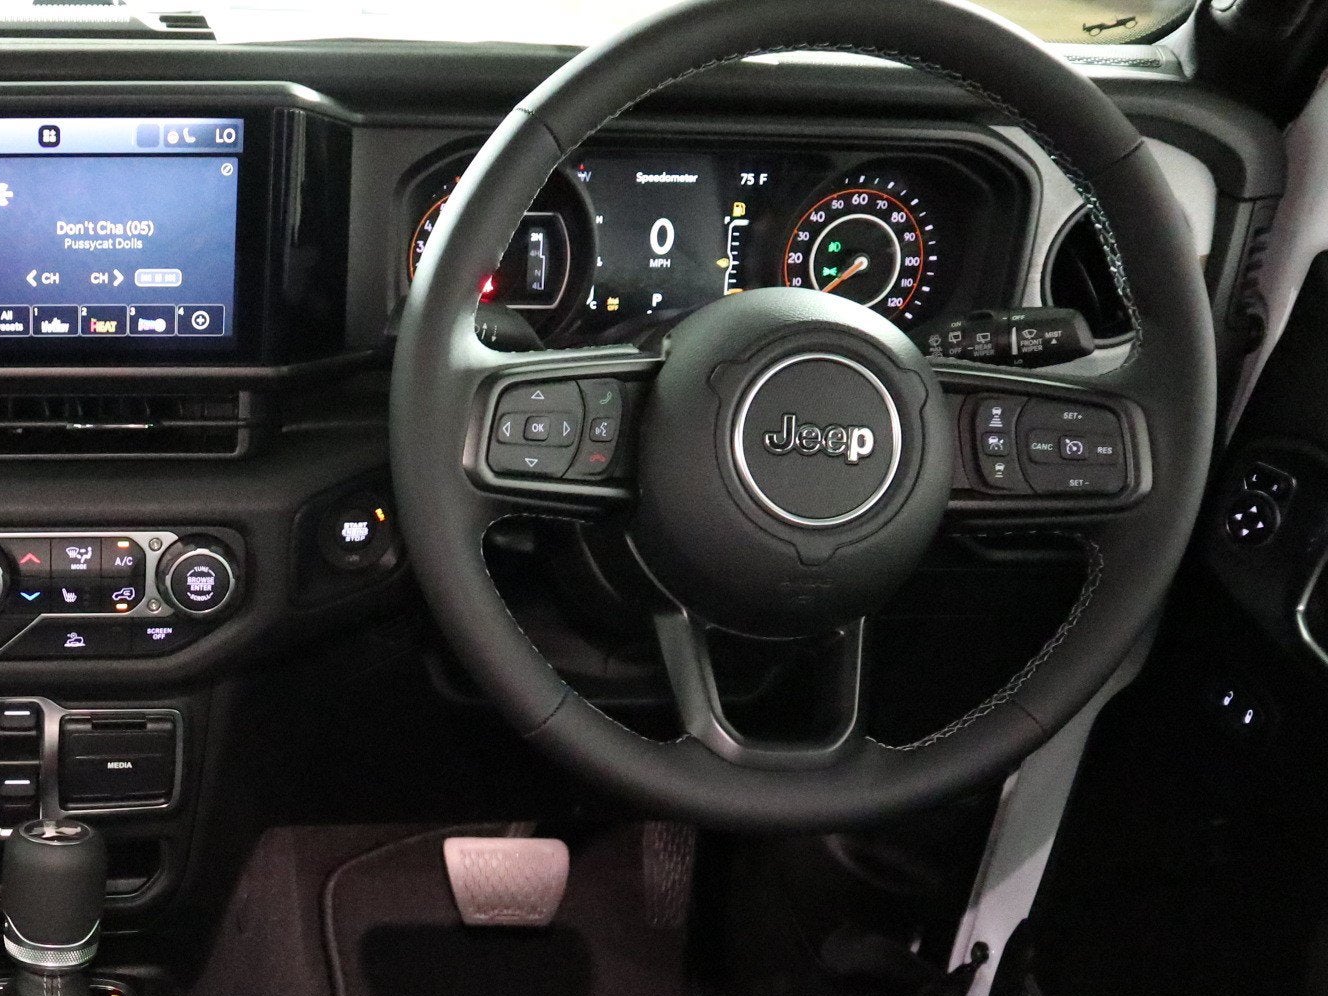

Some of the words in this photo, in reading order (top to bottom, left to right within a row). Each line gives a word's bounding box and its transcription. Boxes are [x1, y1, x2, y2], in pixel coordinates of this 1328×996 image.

[215, 128, 235, 143] LO
[636, 171, 698, 183] Speedometer
[740, 173, 755, 186] 75
[759, 173, 768, 185] F
[832, 199, 844, 210] 50
[852, 194, 868, 205] 60
[876, 200, 888, 210] 70
[810, 211, 825, 223] 40
[891, 212, 906, 223] 80
[56, 221, 95, 235] Don't
[97, 221, 124, 235] Cha
[126, 220, 154, 236] (05)
[649, 218, 675, 255] 0
[797, 231, 810, 242] 30
[904, 231, 916, 242] 90
[64, 238, 113, 251] Pussycat
[115, 238, 143, 249] Dolls
[416, 240, 425, 253] 3
[649, 258, 671, 268] MPH
[788, 252, 803, 264] 20
[905, 256, 920, 267] 100
[41, 272, 60, 284] CH
[91, 272, 109, 284] CH
[792, 276, 802, 287] 10
[901, 277, 914, 287] 110
[652, 293, 662, 307] P
[887, 297, 903, 307] 120
[0, 310, 13, 320] All
[532, 423, 544, 433] OK
[763, 413, 875, 464] Jeep
[1031, 442, 1053, 451] CANC
[1097, 446, 1113, 455] RES
[114, 556, 133, 567] A/C
[107, 761, 132, 769] MEDIA
